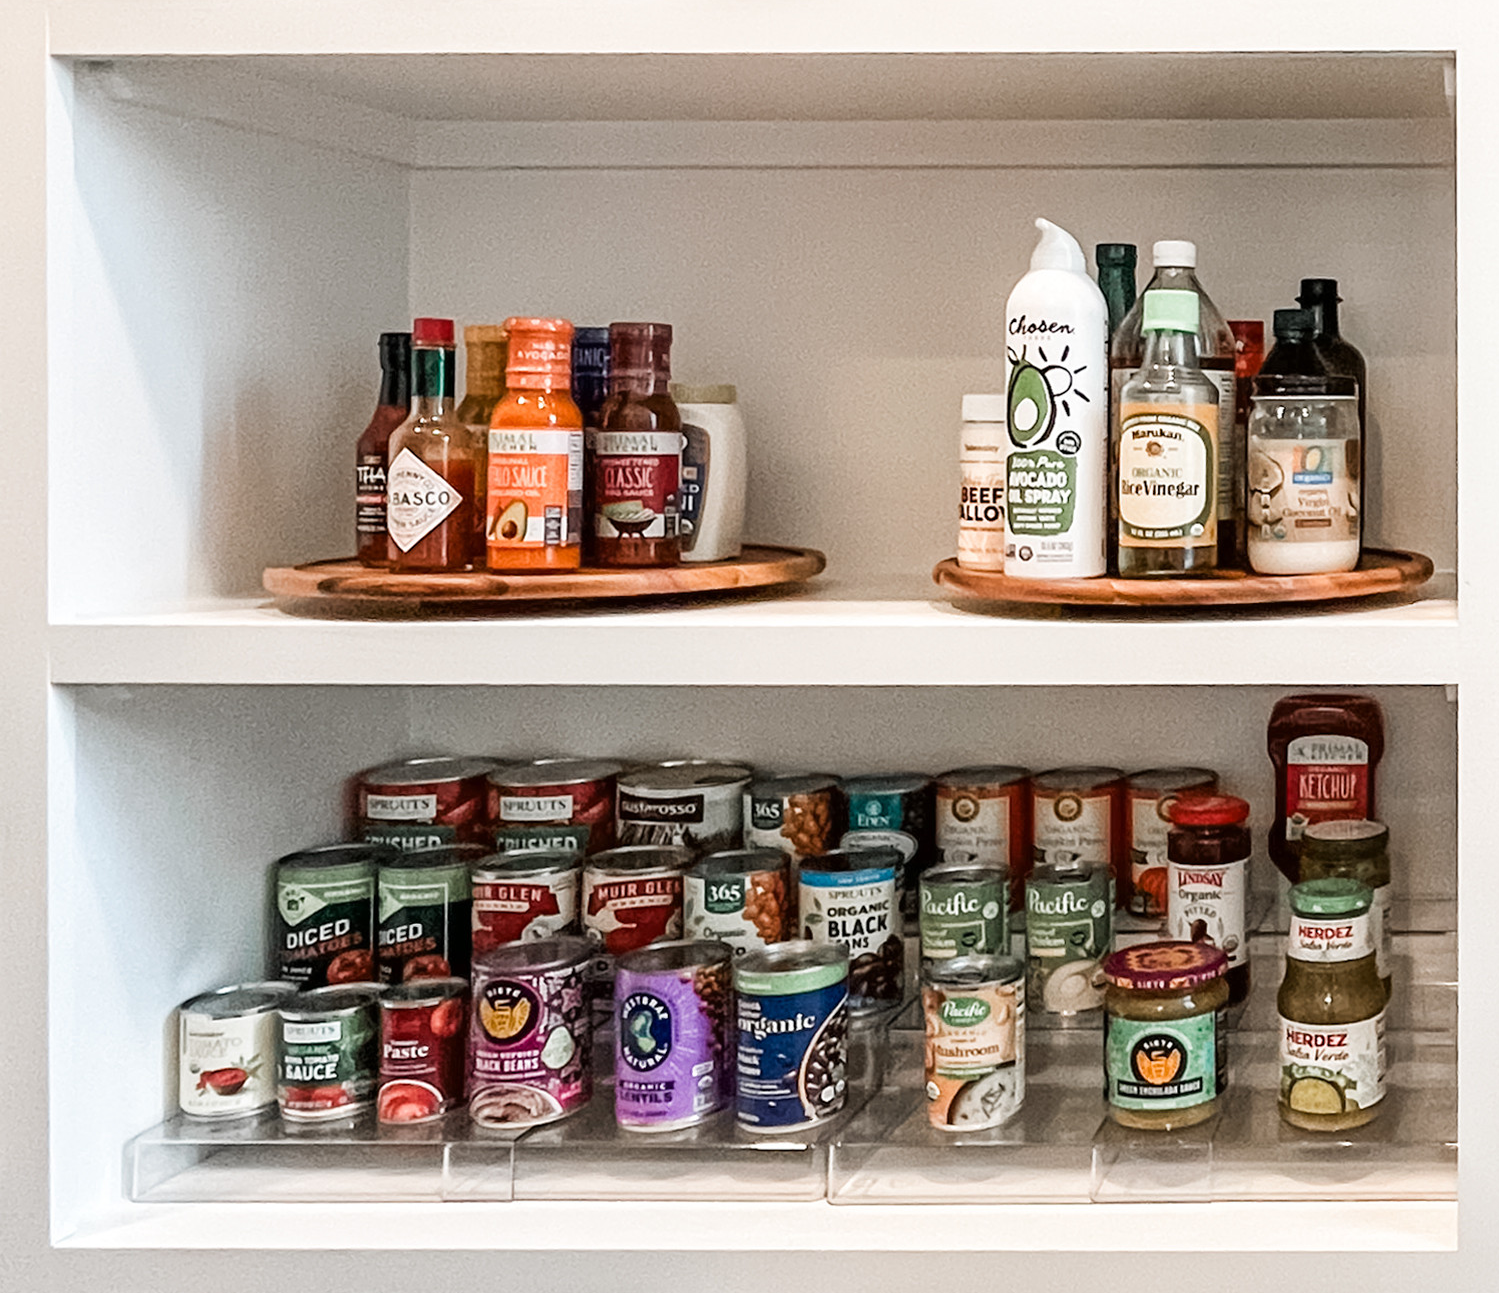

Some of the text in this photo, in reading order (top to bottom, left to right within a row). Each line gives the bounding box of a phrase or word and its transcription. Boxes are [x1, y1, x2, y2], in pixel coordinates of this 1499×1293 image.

[1008, 314, 1075, 335] Chosen
[1131, 428, 1183, 440] Marukan
[1037, 456, 1065, 469] Pure
[1009, 471, 1068, 487] AVOCADO
[1131, 468, 1182, 478] ORGANIC
[962, 487, 1004, 503] BEEF
[1025, 488, 1072, 504] SPRAY
[1300, 774, 1357, 799] KETCHUP
[503, 799, 567, 812] SPROUTS
[754, 803, 779, 818] 365
[1178, 871, 1226, 888] LINDSAY
[499, 887, 542, 902] GLEN
[598, 885, 638, 900] MUIR
[707, 885, 741, 901] 365
[828, 888, 882, 900] SPROUTS
[1179, 889, 1221, 903] Organic
[827, 899, 889, 918] ORGANIC
[921, 889, 980, 916] Pacific
[1028, 888, 1088, 915] Pacific
[828, 913, 888, 938] BLACK
[1298, 925, 1354, 940] HERDEZ
[286, 918, 350, 950] DICED
[941, 1000, 986, 1018] Pacific
[738, 1013, 816, 1041] organic
[1287, 1028, 1348, 1048] HERDEZ
[384, 1043, 430, 1059] Paste
[1315, 1048, 1349, 1061] Verde
[286, 1063, 338, 1081] SAUCE
[502, 1058, 539, 1073] BEANS
